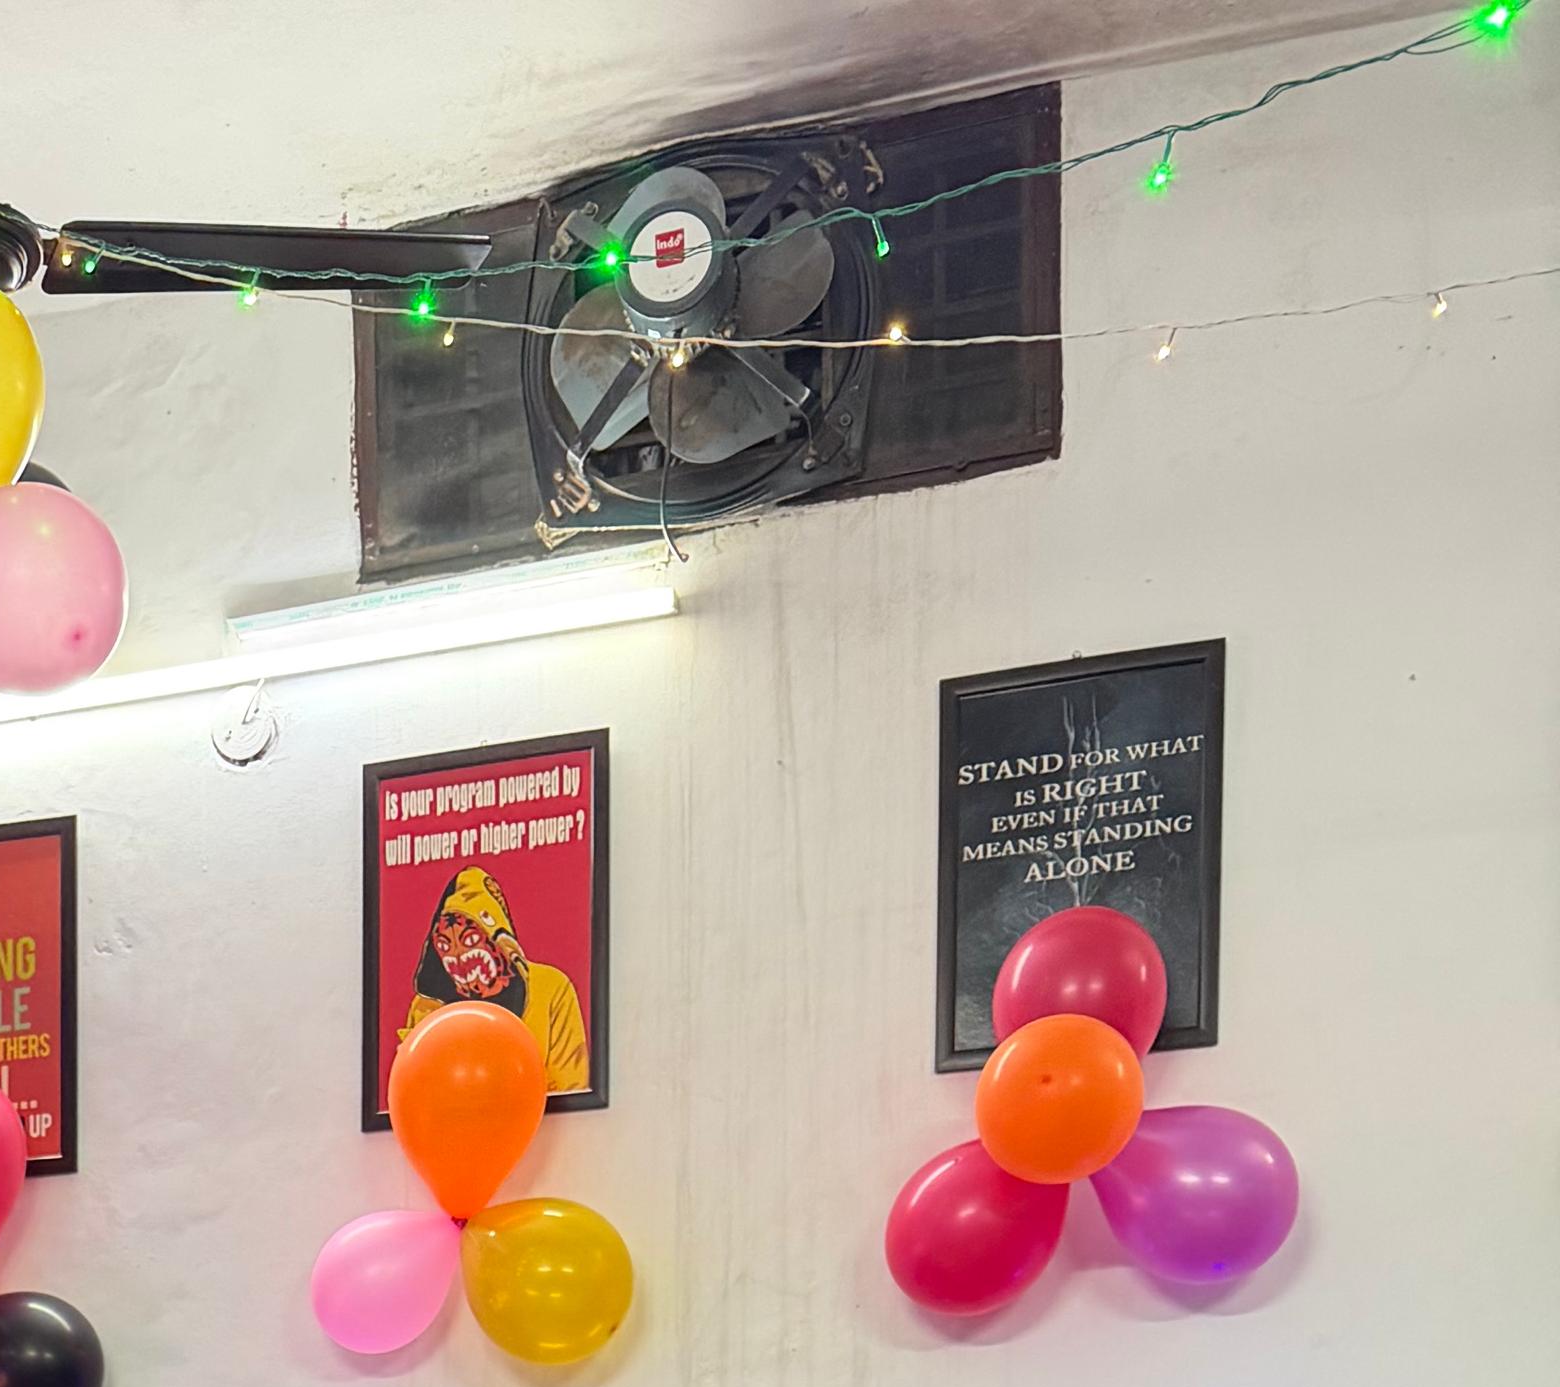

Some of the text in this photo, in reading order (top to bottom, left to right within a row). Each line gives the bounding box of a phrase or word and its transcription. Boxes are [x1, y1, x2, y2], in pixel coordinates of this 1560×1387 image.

[958, 734, 1205, 786] STAND FOR WHAT
[401, 788, 434, 821] your
[436, 779, 496, 816] program
[499, 766, 560, 808] powered
[562, 765, 581, 797] by
[1014, 770, 1147, 808] IS RIGHT
[991, 794, 1165, 834] EVEN IF THAT
[385, 834, 411, 866] will
[413, 829, 458, 866] power
[460, 828, 478, 857] or
[480, 820, 526, 855] higher
[528, 814, 574, 850] power
[961, 814, 1193, 863] MEANS STANDING
[1024, 850, 1136, 883] ALONE
[29, 1113, 52, 1138] UP
